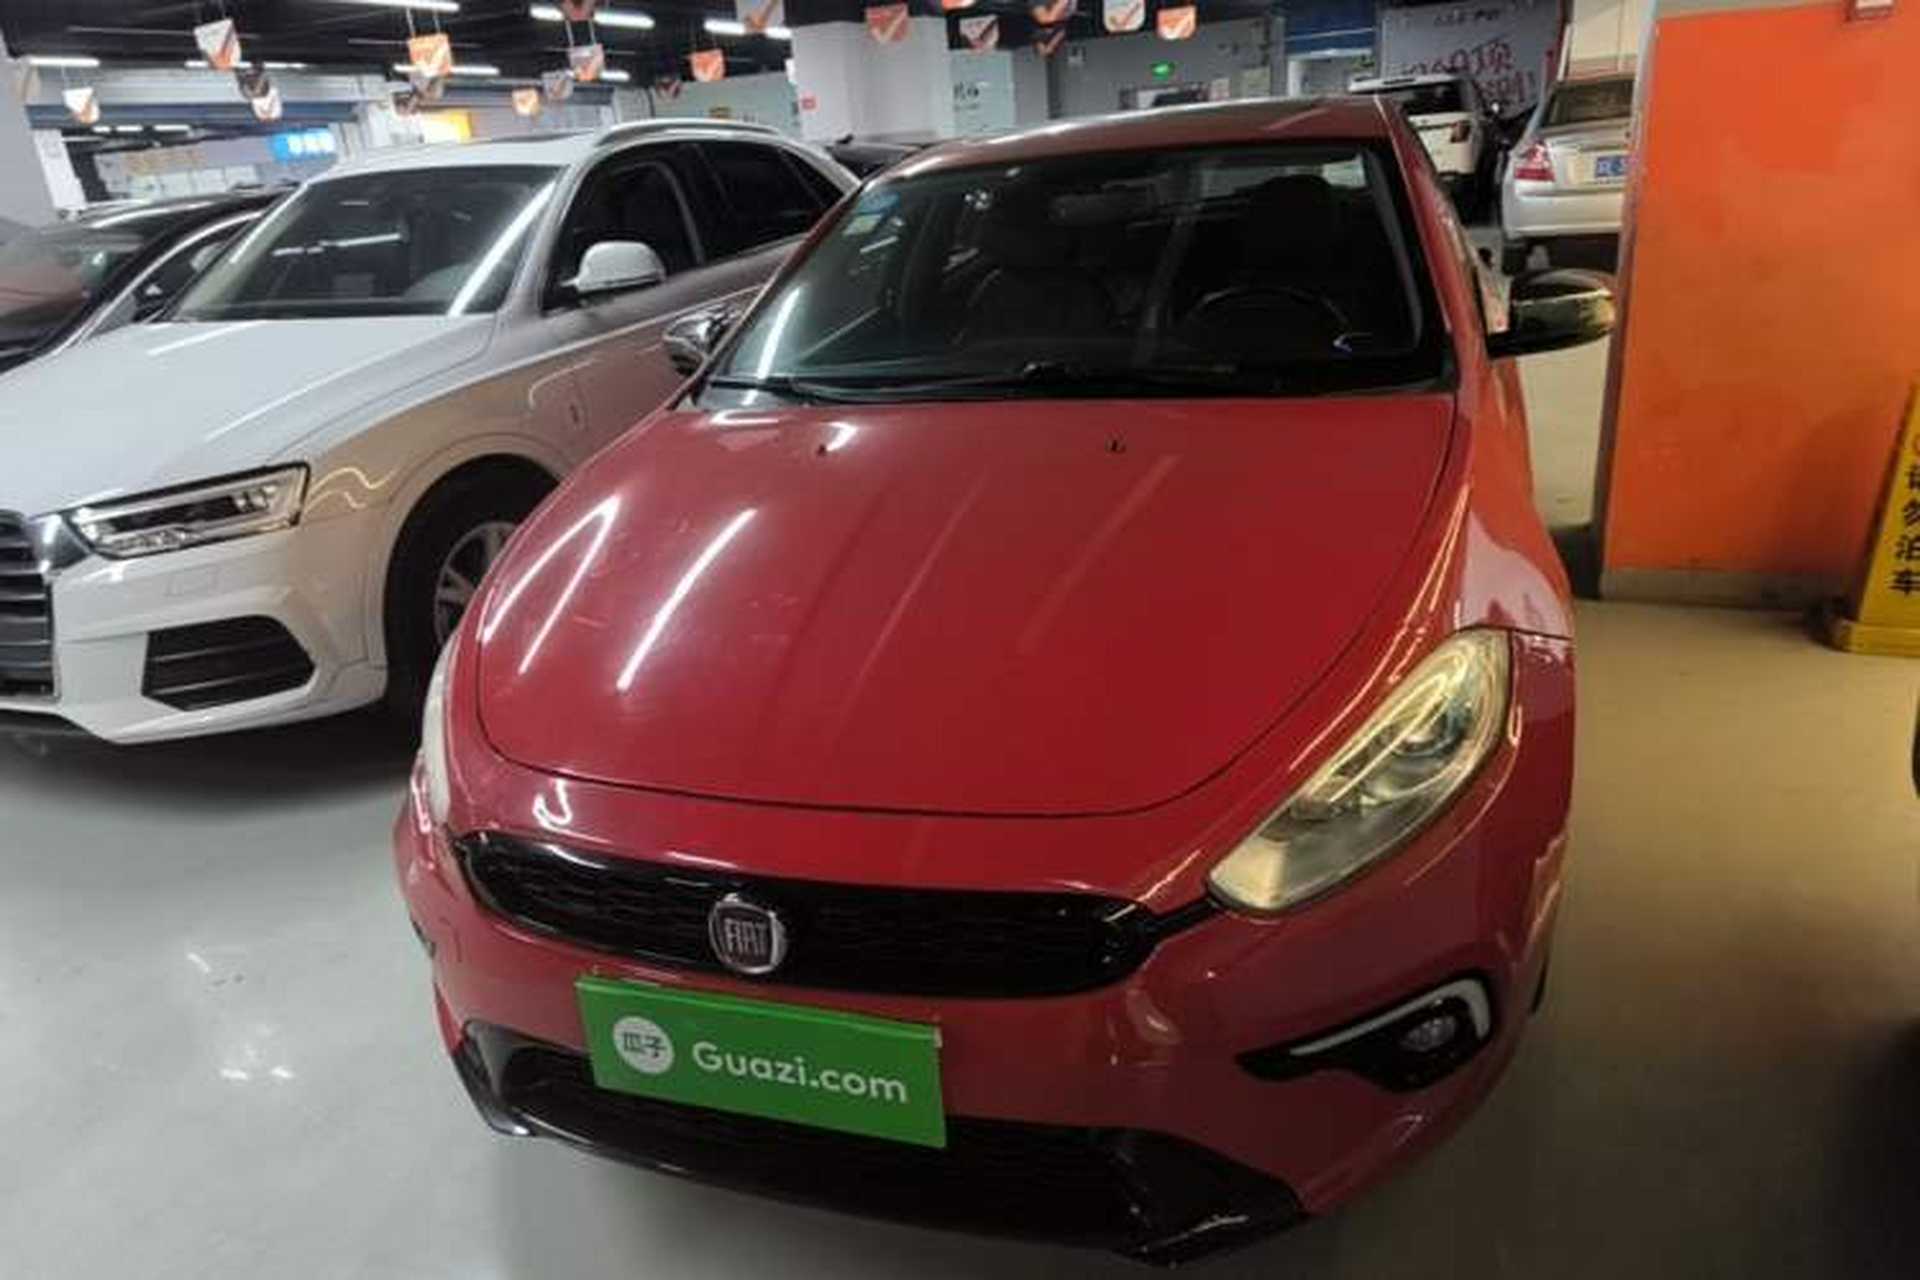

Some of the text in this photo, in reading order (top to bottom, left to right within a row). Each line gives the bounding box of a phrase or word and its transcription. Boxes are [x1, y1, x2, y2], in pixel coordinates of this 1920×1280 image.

[724, 917, 767, 955] FIAT
[622, 1031, 668, 1059] 瓜子
[692, 1041, 908, 1103] Guazi.com
